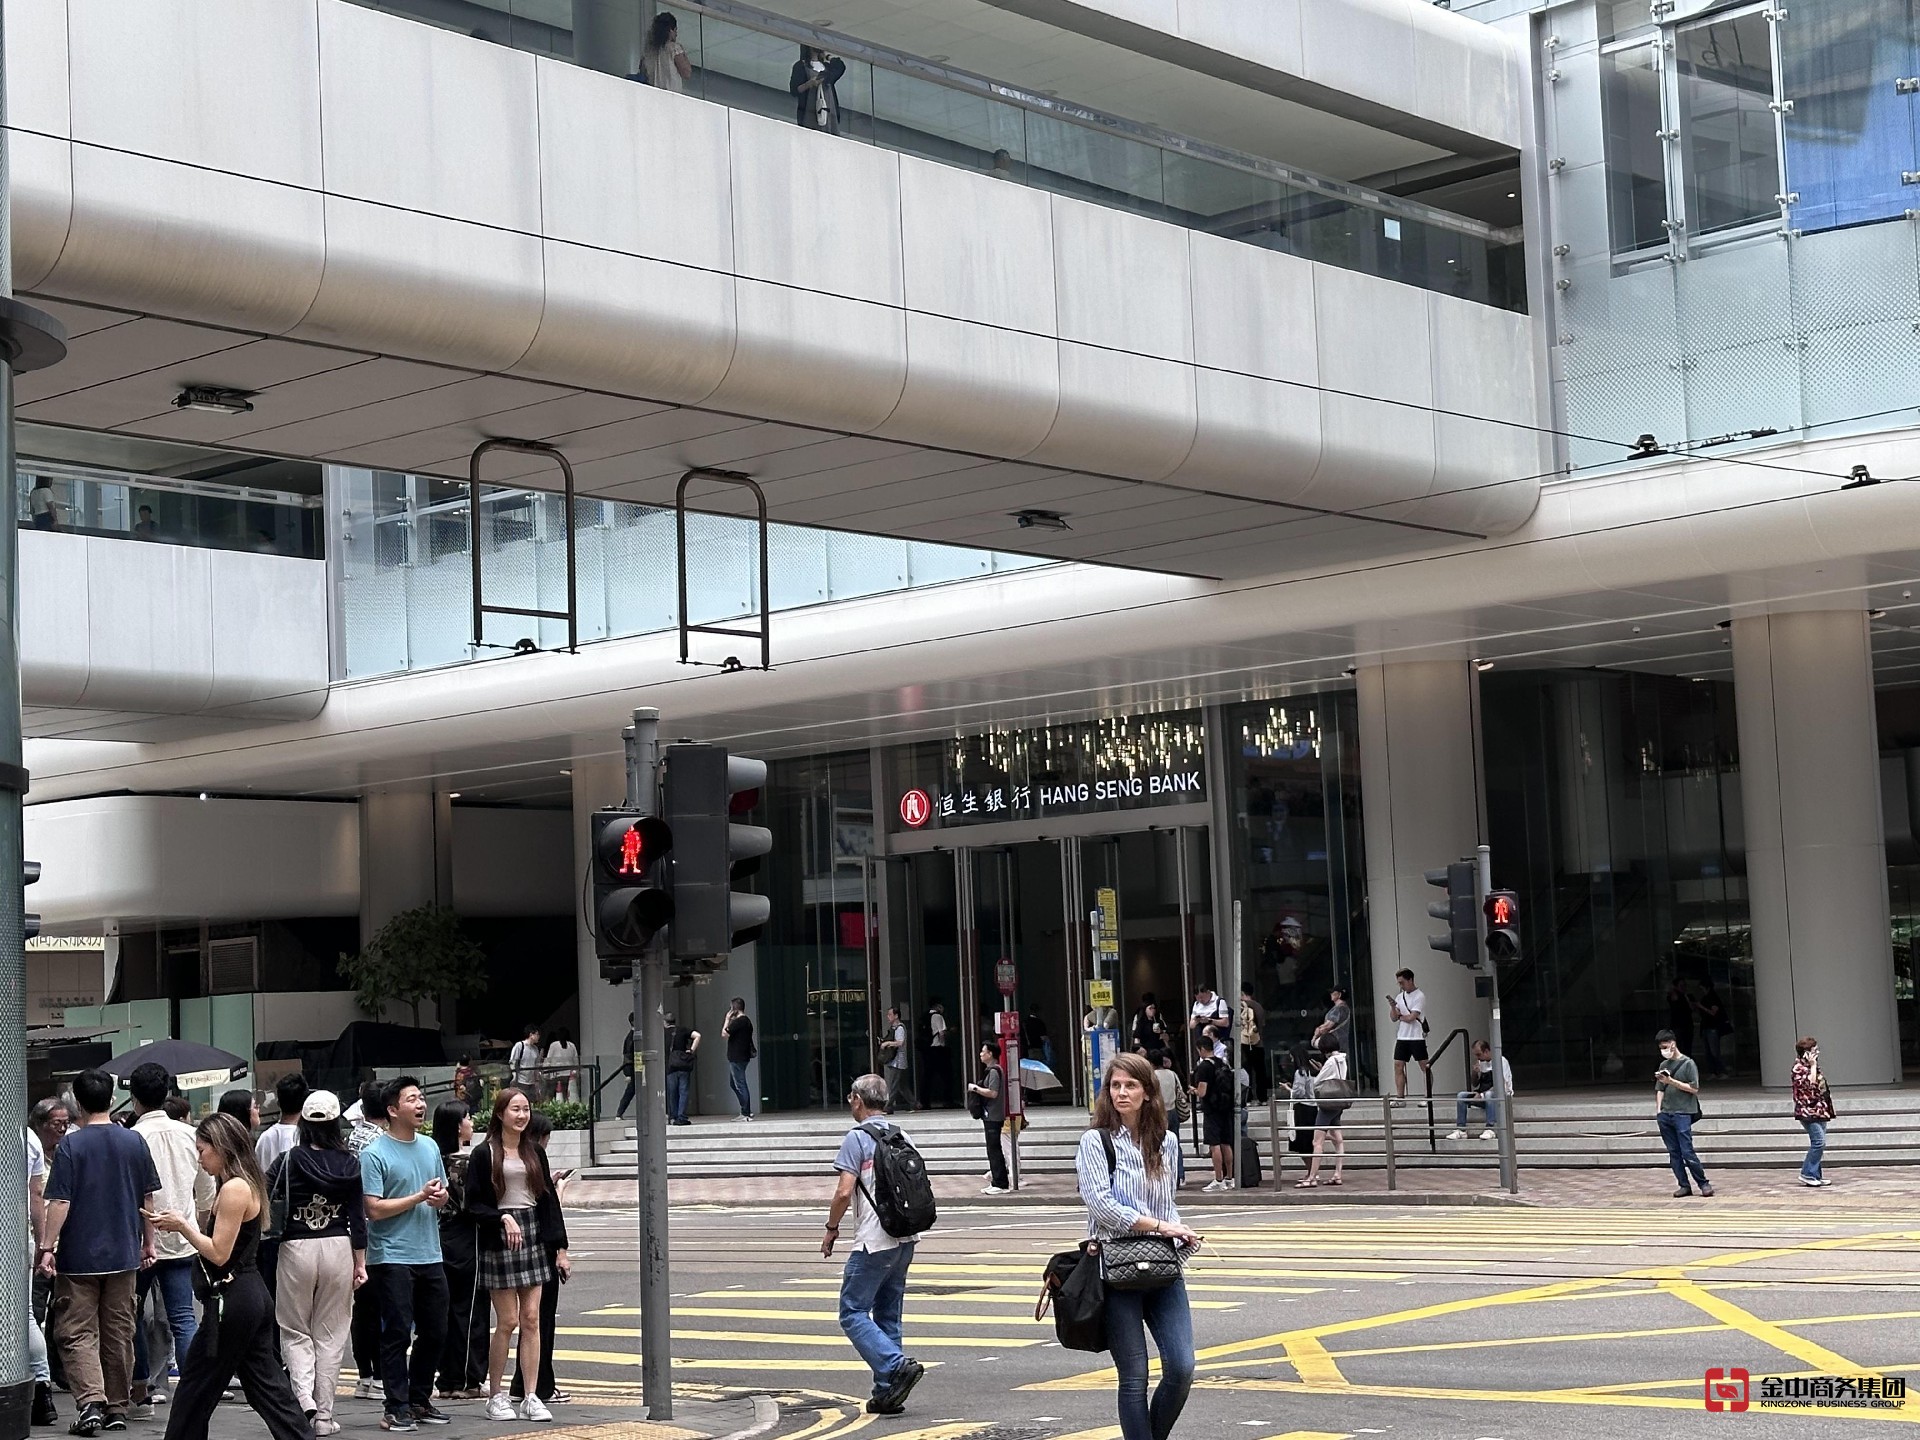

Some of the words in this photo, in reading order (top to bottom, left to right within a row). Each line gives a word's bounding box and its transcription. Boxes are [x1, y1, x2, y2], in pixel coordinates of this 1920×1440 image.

[935, 787, 1030, 817] 恒生銀行
[1040, 783, 1088, 806] HANG
[1095, 777, 1143, 800] SENG
[1149, 771, 1201, 794] BANK
